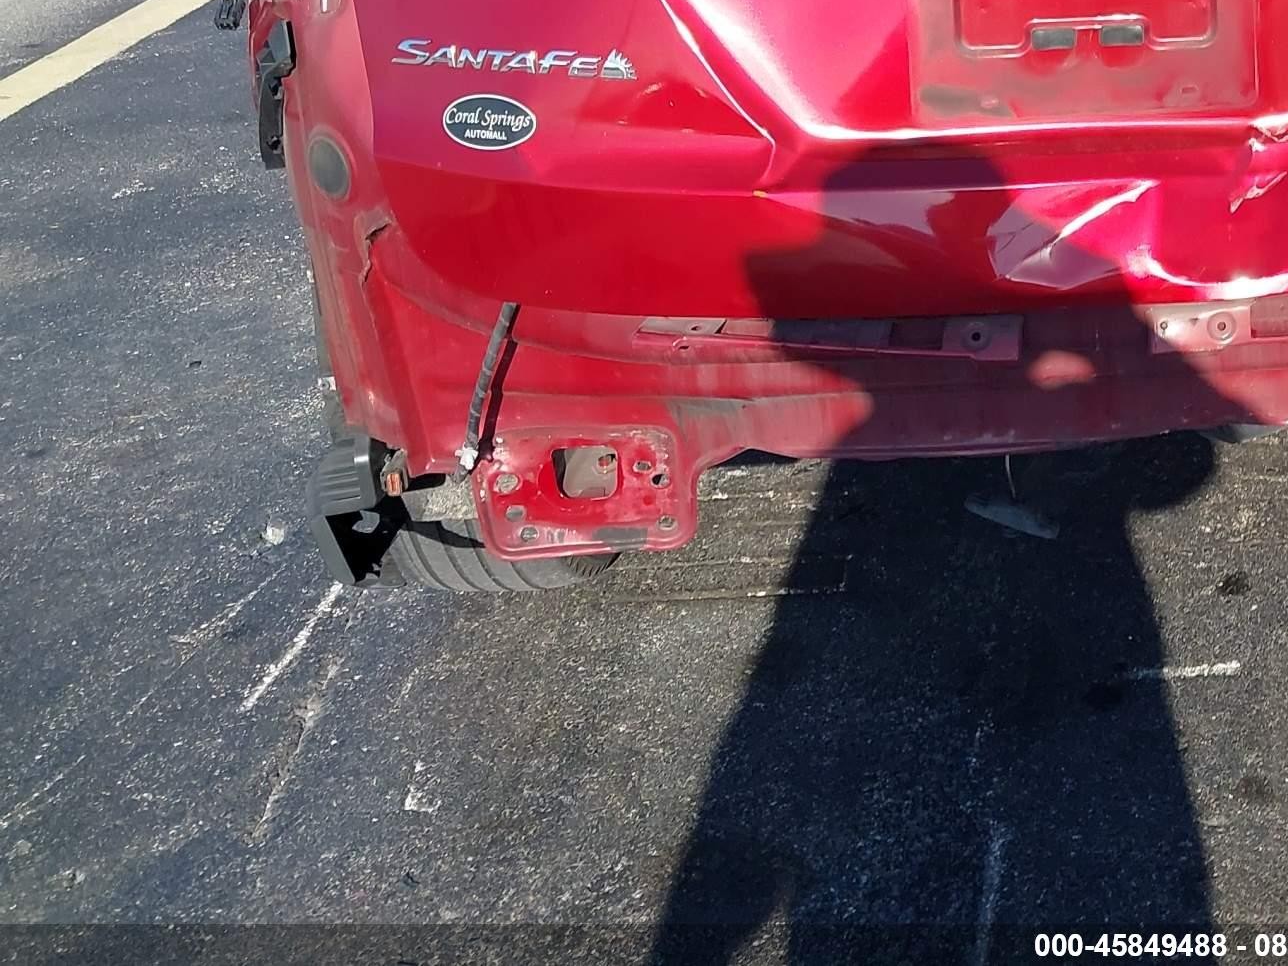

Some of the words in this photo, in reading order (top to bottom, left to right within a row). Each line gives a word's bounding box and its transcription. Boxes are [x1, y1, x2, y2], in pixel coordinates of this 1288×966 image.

[445, 106, 482, 125] Coral
[481, 109, 532, 132] Springs
[464, 128, 508, 141] AUTOMALL
